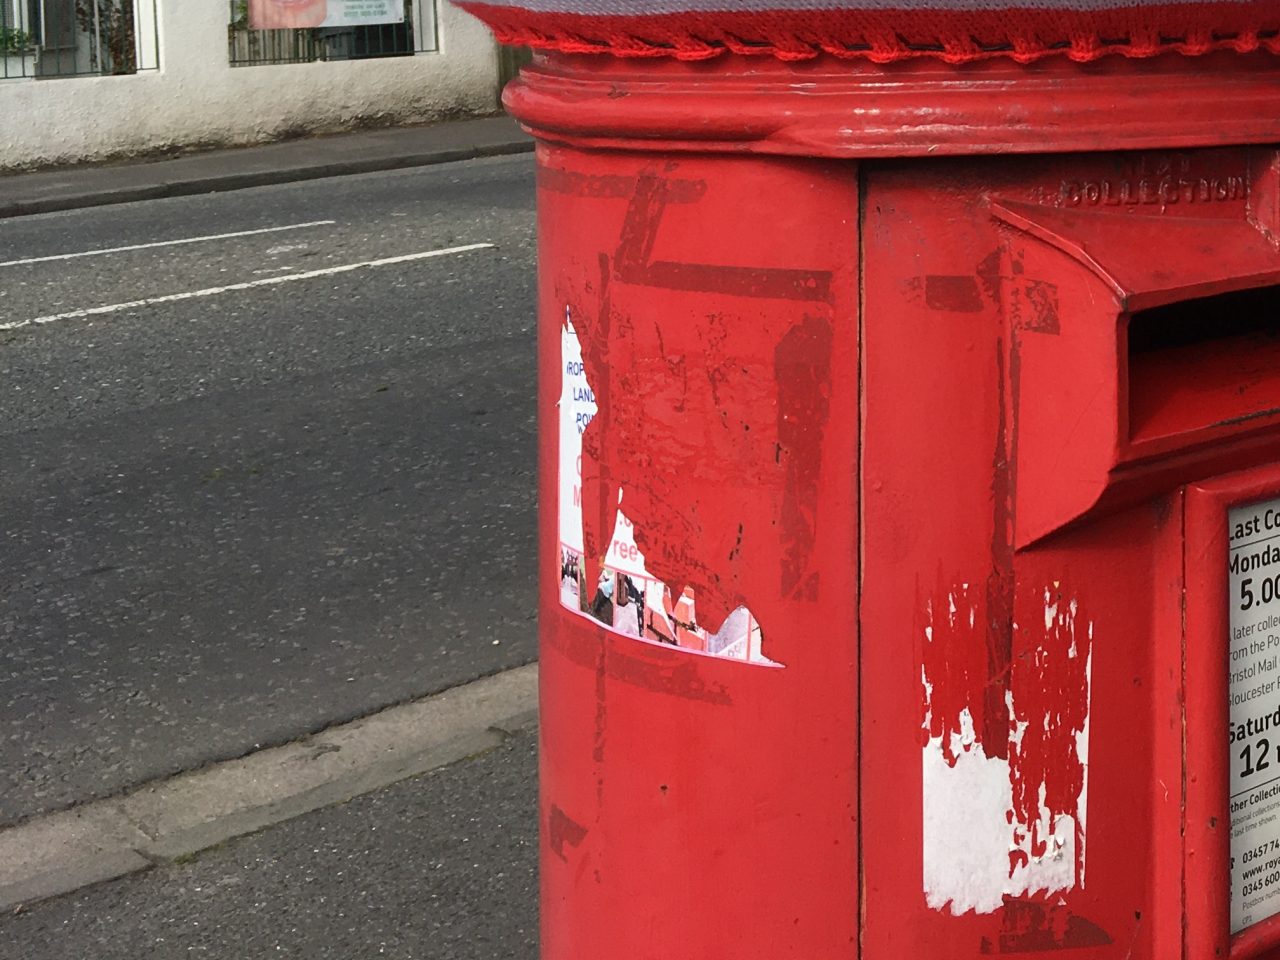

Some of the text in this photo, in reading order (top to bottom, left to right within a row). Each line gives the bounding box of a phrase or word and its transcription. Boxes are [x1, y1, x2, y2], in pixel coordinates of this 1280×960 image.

[1233, 623, 1256, 641] later
[1229, 646, 1248, 662] rom
[1250, 640, 1265, 656] the
[1258, 655, 1277, 675] Mail
[1239, 738, 1270, 778] 12
[1230, 800, 1248, 814] ther
[1252, 802, 1280, 818] collections
[1242, 844, 1268, 863] 03457
[1242, 881, 1263, 897] 0345
